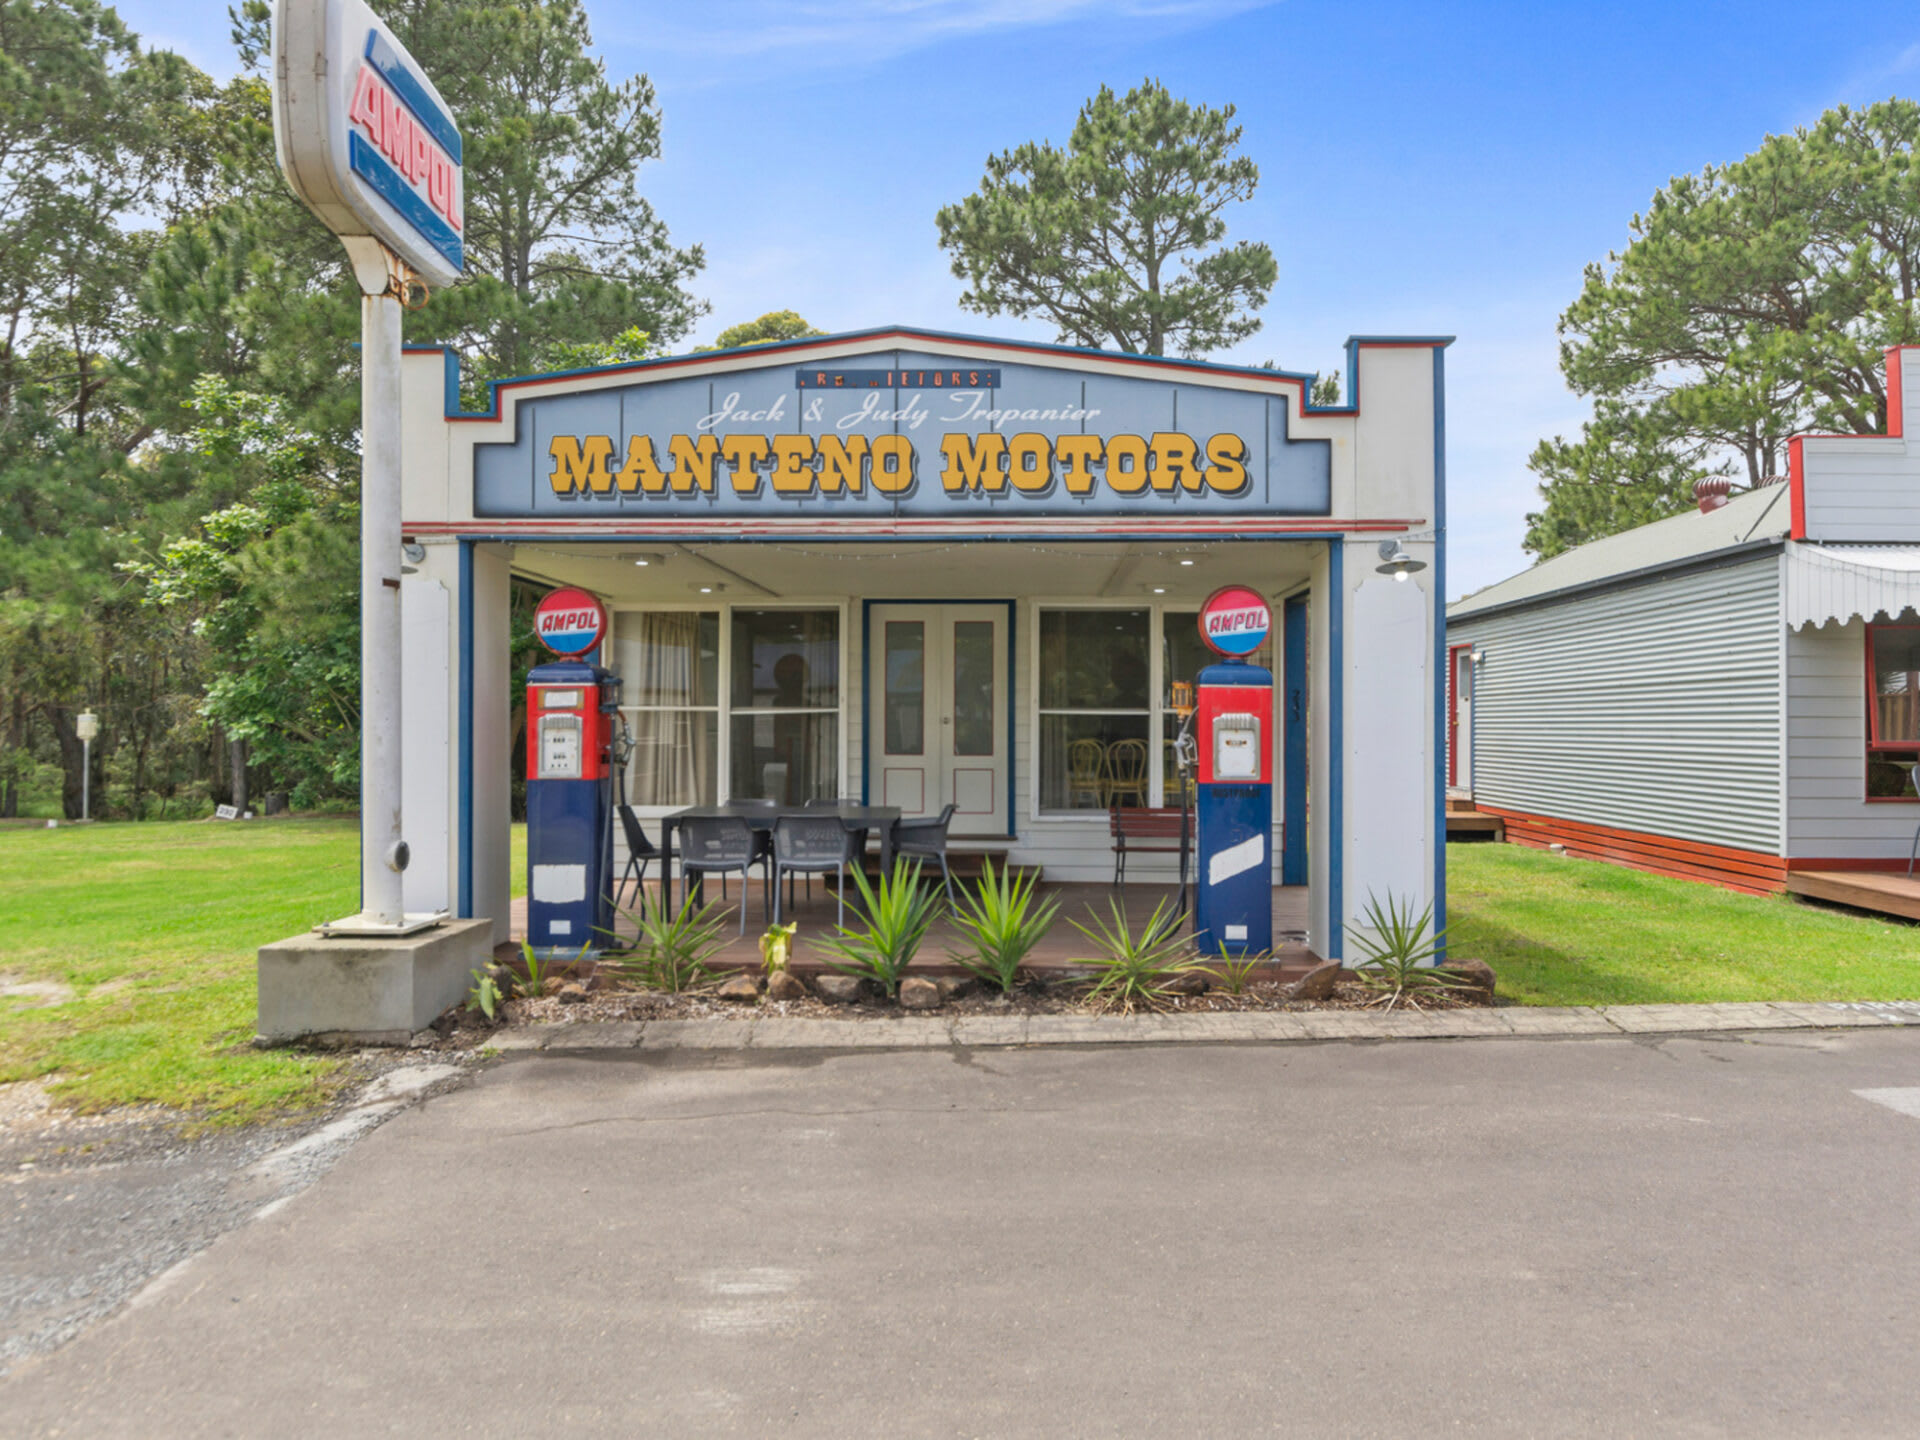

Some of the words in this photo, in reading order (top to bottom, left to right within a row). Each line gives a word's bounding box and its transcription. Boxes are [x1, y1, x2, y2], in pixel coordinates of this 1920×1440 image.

[350, 66, 461, 231] AMPOL
[800, 371, 993, 388] RIETORS:
[696, 392, 786, 430] Jack
[803, 397, 825, 422] &
[836, 391, 929, 430] Judy
[940, 391, 1101, 430] Trepanier
[548, 434, 918, 499] MANTENO
[940, 432, 1253, 499] MOTORS
[542, 610, 598, 632] AMPOL
[1209, 610, 1266, 633] AMPOL
